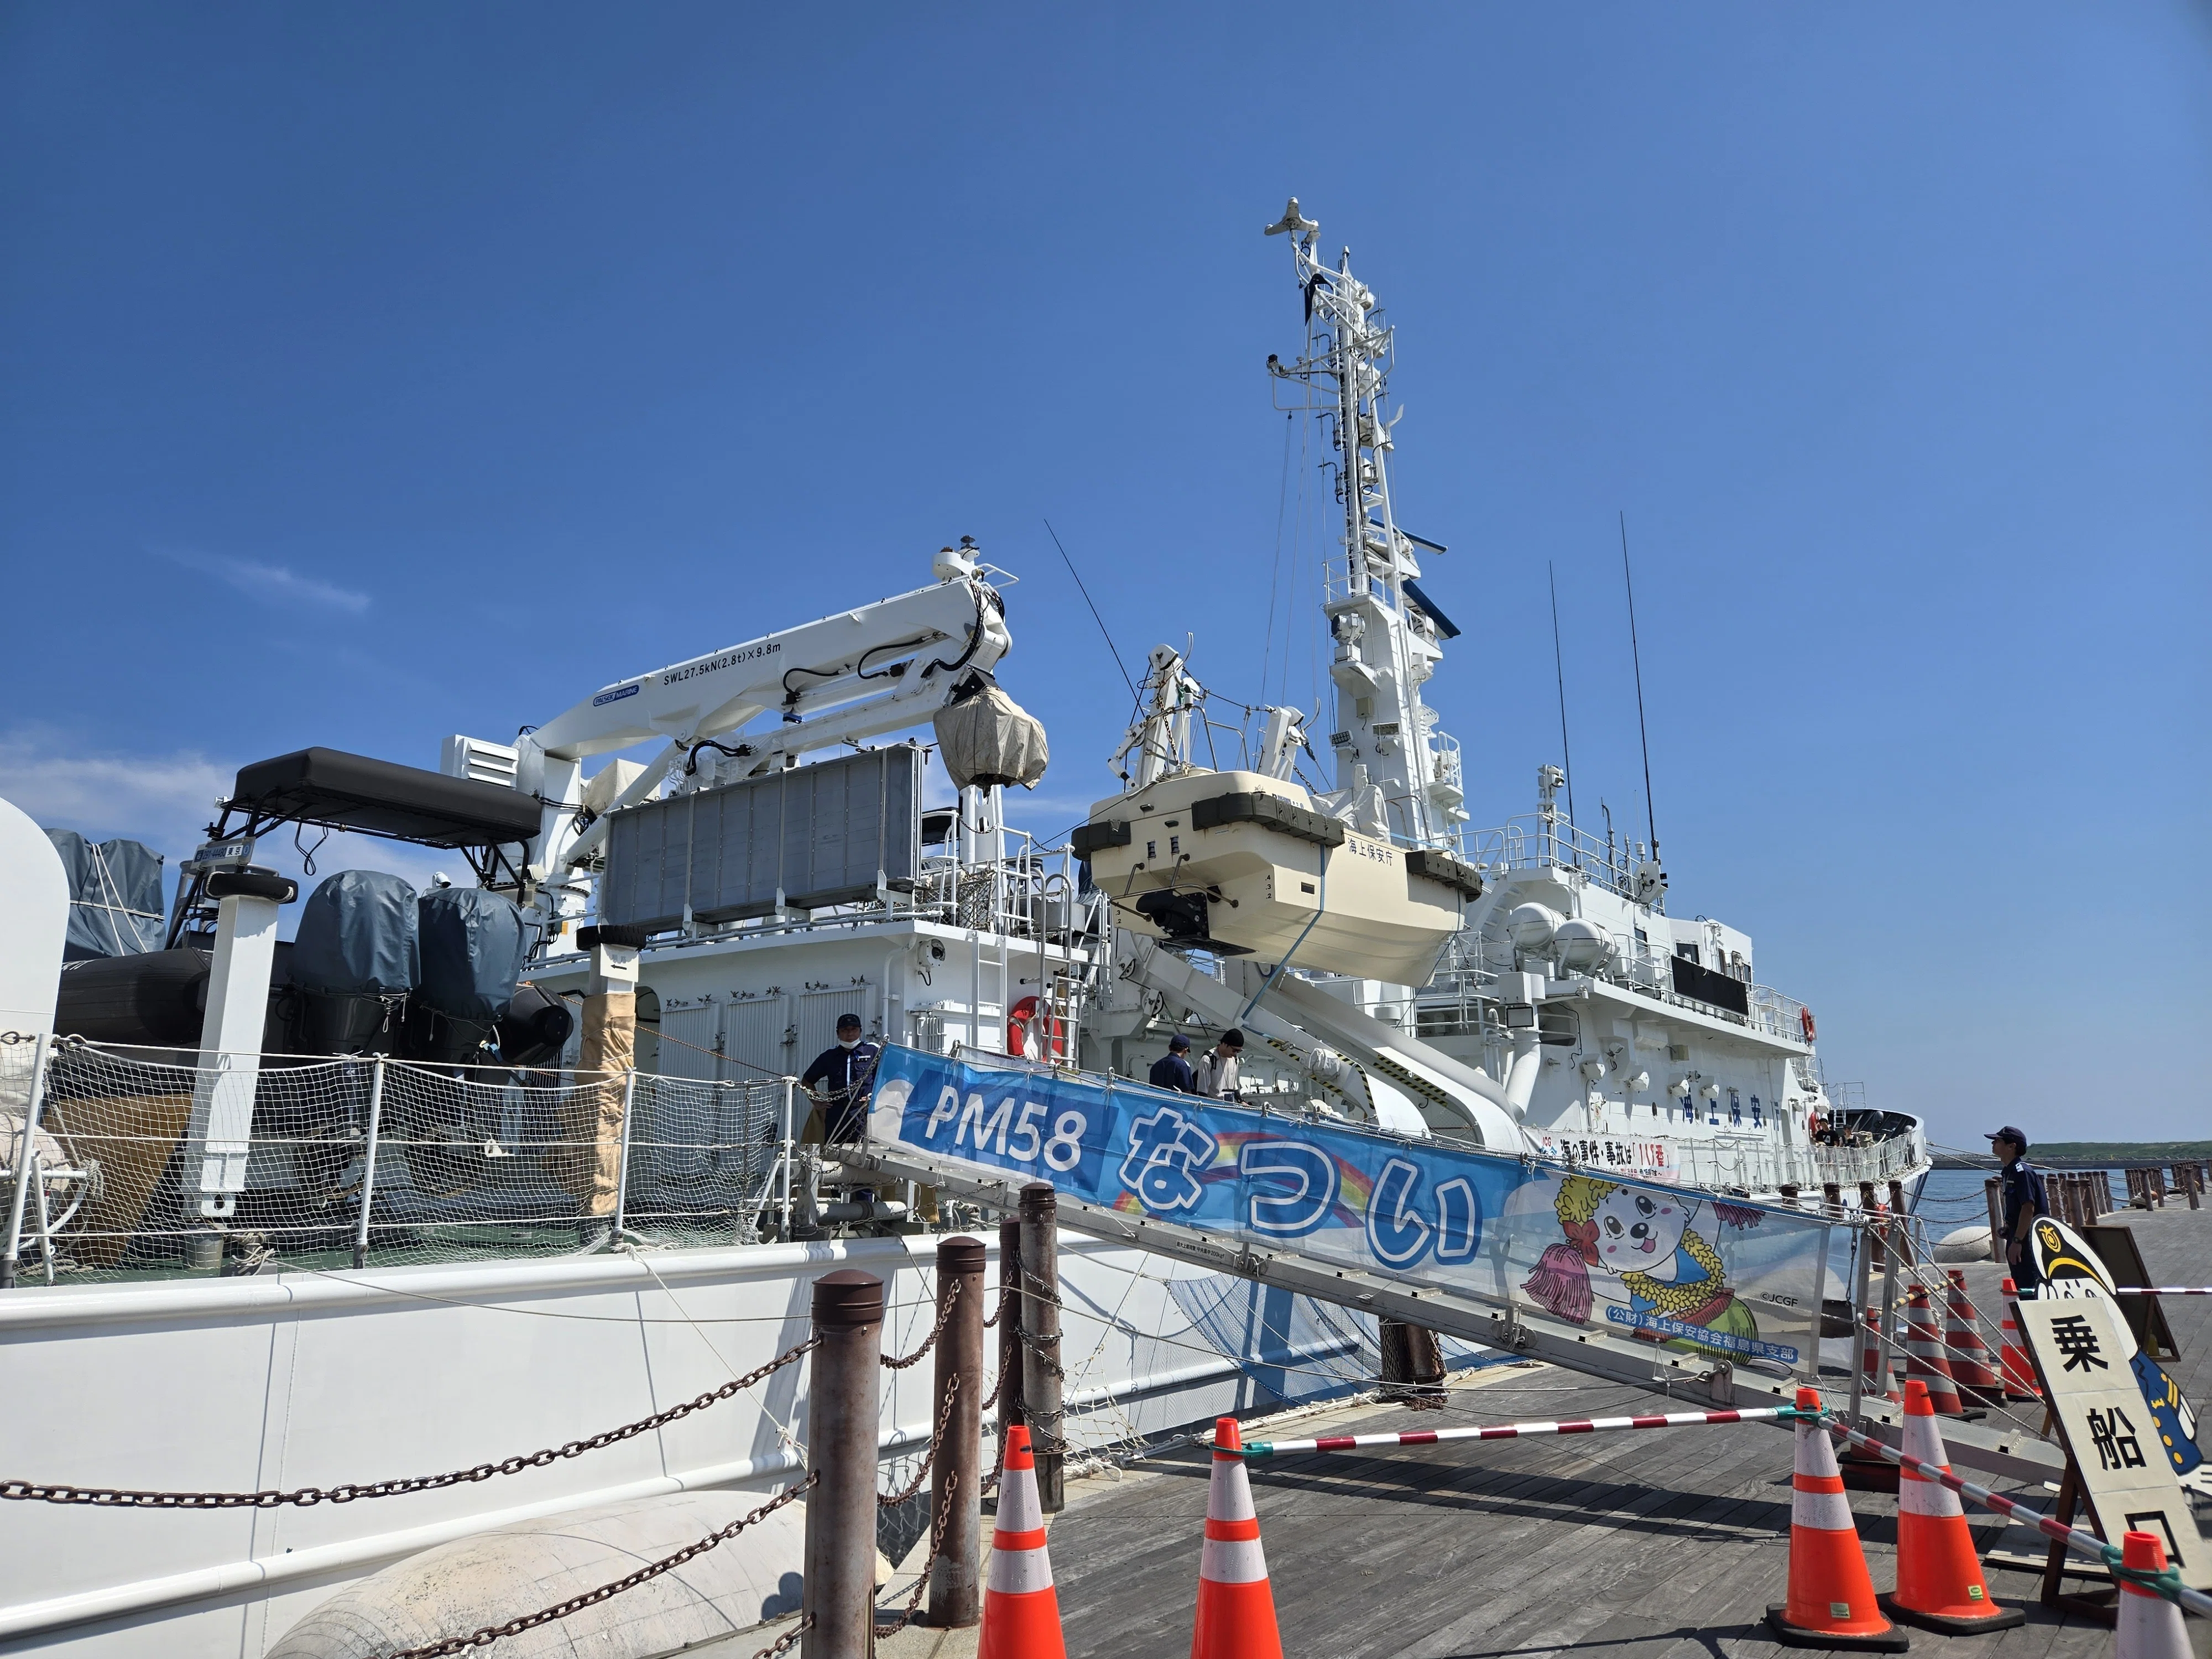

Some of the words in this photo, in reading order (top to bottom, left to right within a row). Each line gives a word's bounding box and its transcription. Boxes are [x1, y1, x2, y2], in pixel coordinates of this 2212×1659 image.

[615, 687, 638, 698] MARINE
[227, 847, 242, 856] 東京
[1348, 836, 1393, 866] 海上保安庁
[925, 1084, 1088, 1172] PM58
[1117, 1104, 1483, 1271] なつい
